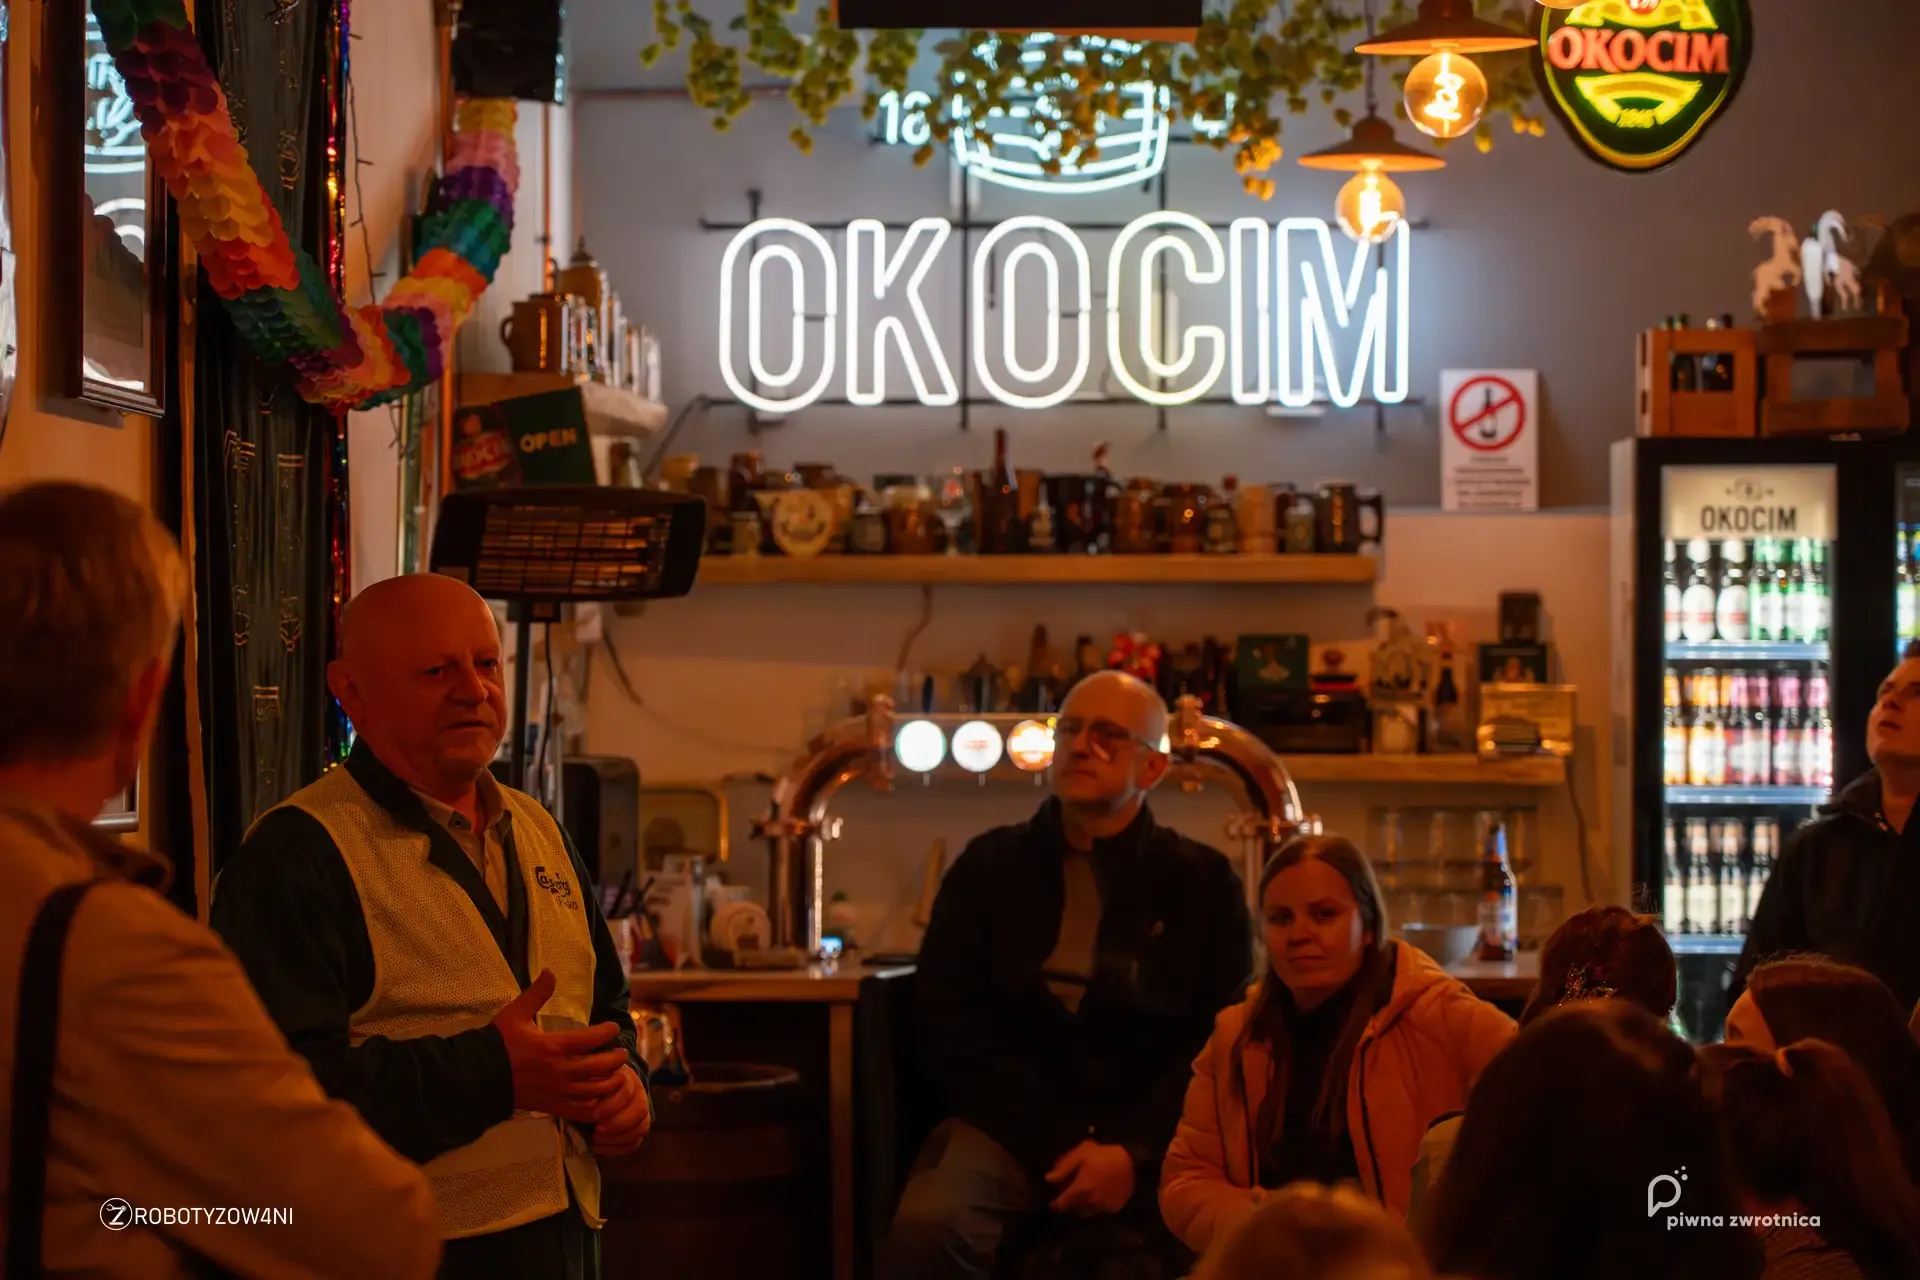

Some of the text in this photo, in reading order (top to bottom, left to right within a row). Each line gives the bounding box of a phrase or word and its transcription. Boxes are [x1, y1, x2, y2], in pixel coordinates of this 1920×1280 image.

[1547, 26, 1729, 73] OKOCIM
[719, 210, 1411, 413] OKOCIM
[520, 427, 577, 453] OPEN
[1701, 506, 1798, 533] OKOCIM
